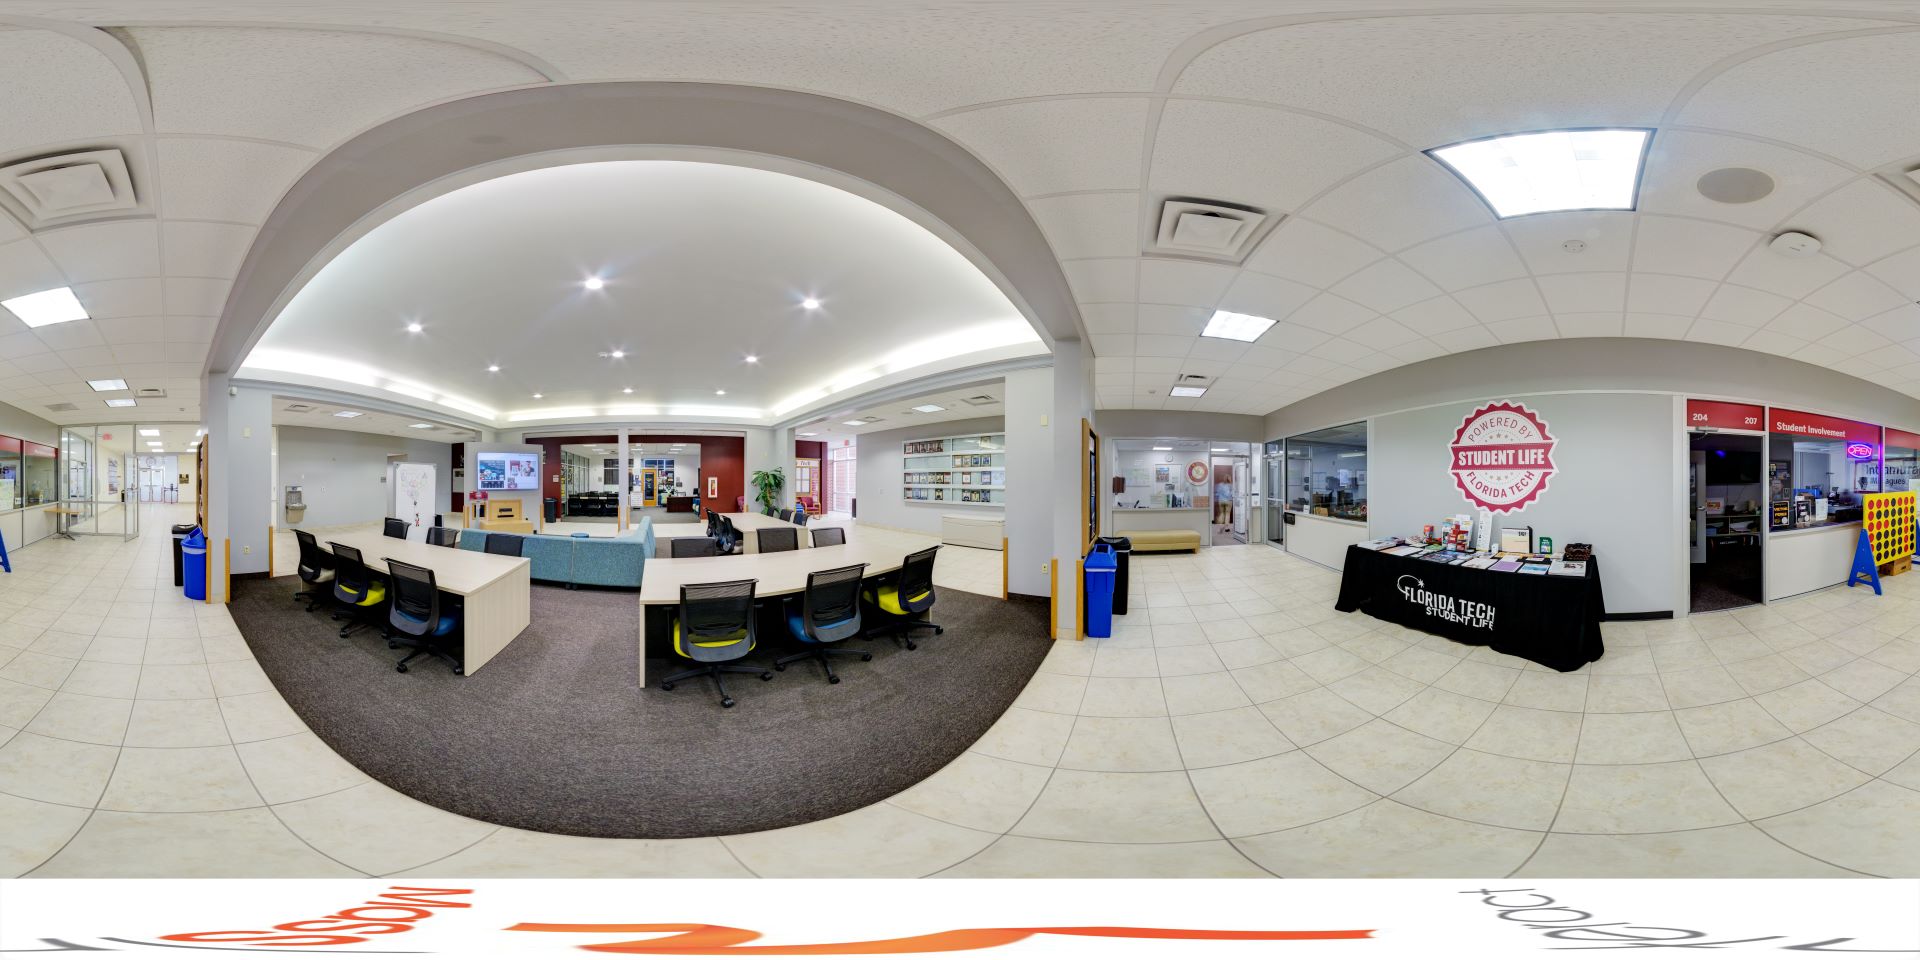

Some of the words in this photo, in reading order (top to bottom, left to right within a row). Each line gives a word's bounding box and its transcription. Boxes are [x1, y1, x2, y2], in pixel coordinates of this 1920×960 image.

[1468, 417, 1518, 442] POWERED
[1518, 425, 1533, 439] BY
[1692, 413, 1708, 422] 204
[1744, 417, 1758, 425] 207
[1776, 421, 1806, 433] Student
[1807, 425, 1846, 438] Involvement
[1458, 449, 1516, 466] STUDENT
[1517, 448, 1545, 465] LIFE
[1848, 446, 1872, 456] OPEN
[1466, 471, 1508, 498] FLORIDA
[1508, 470, 1535, 496] TECH
[1404, 586, 1455, 613] FLORIDA
[1458, 599, 1496, 622] TECH
[1426, 606, 1471, 626] STUDENT
[1472, 617, 1494, 631] LIFE
